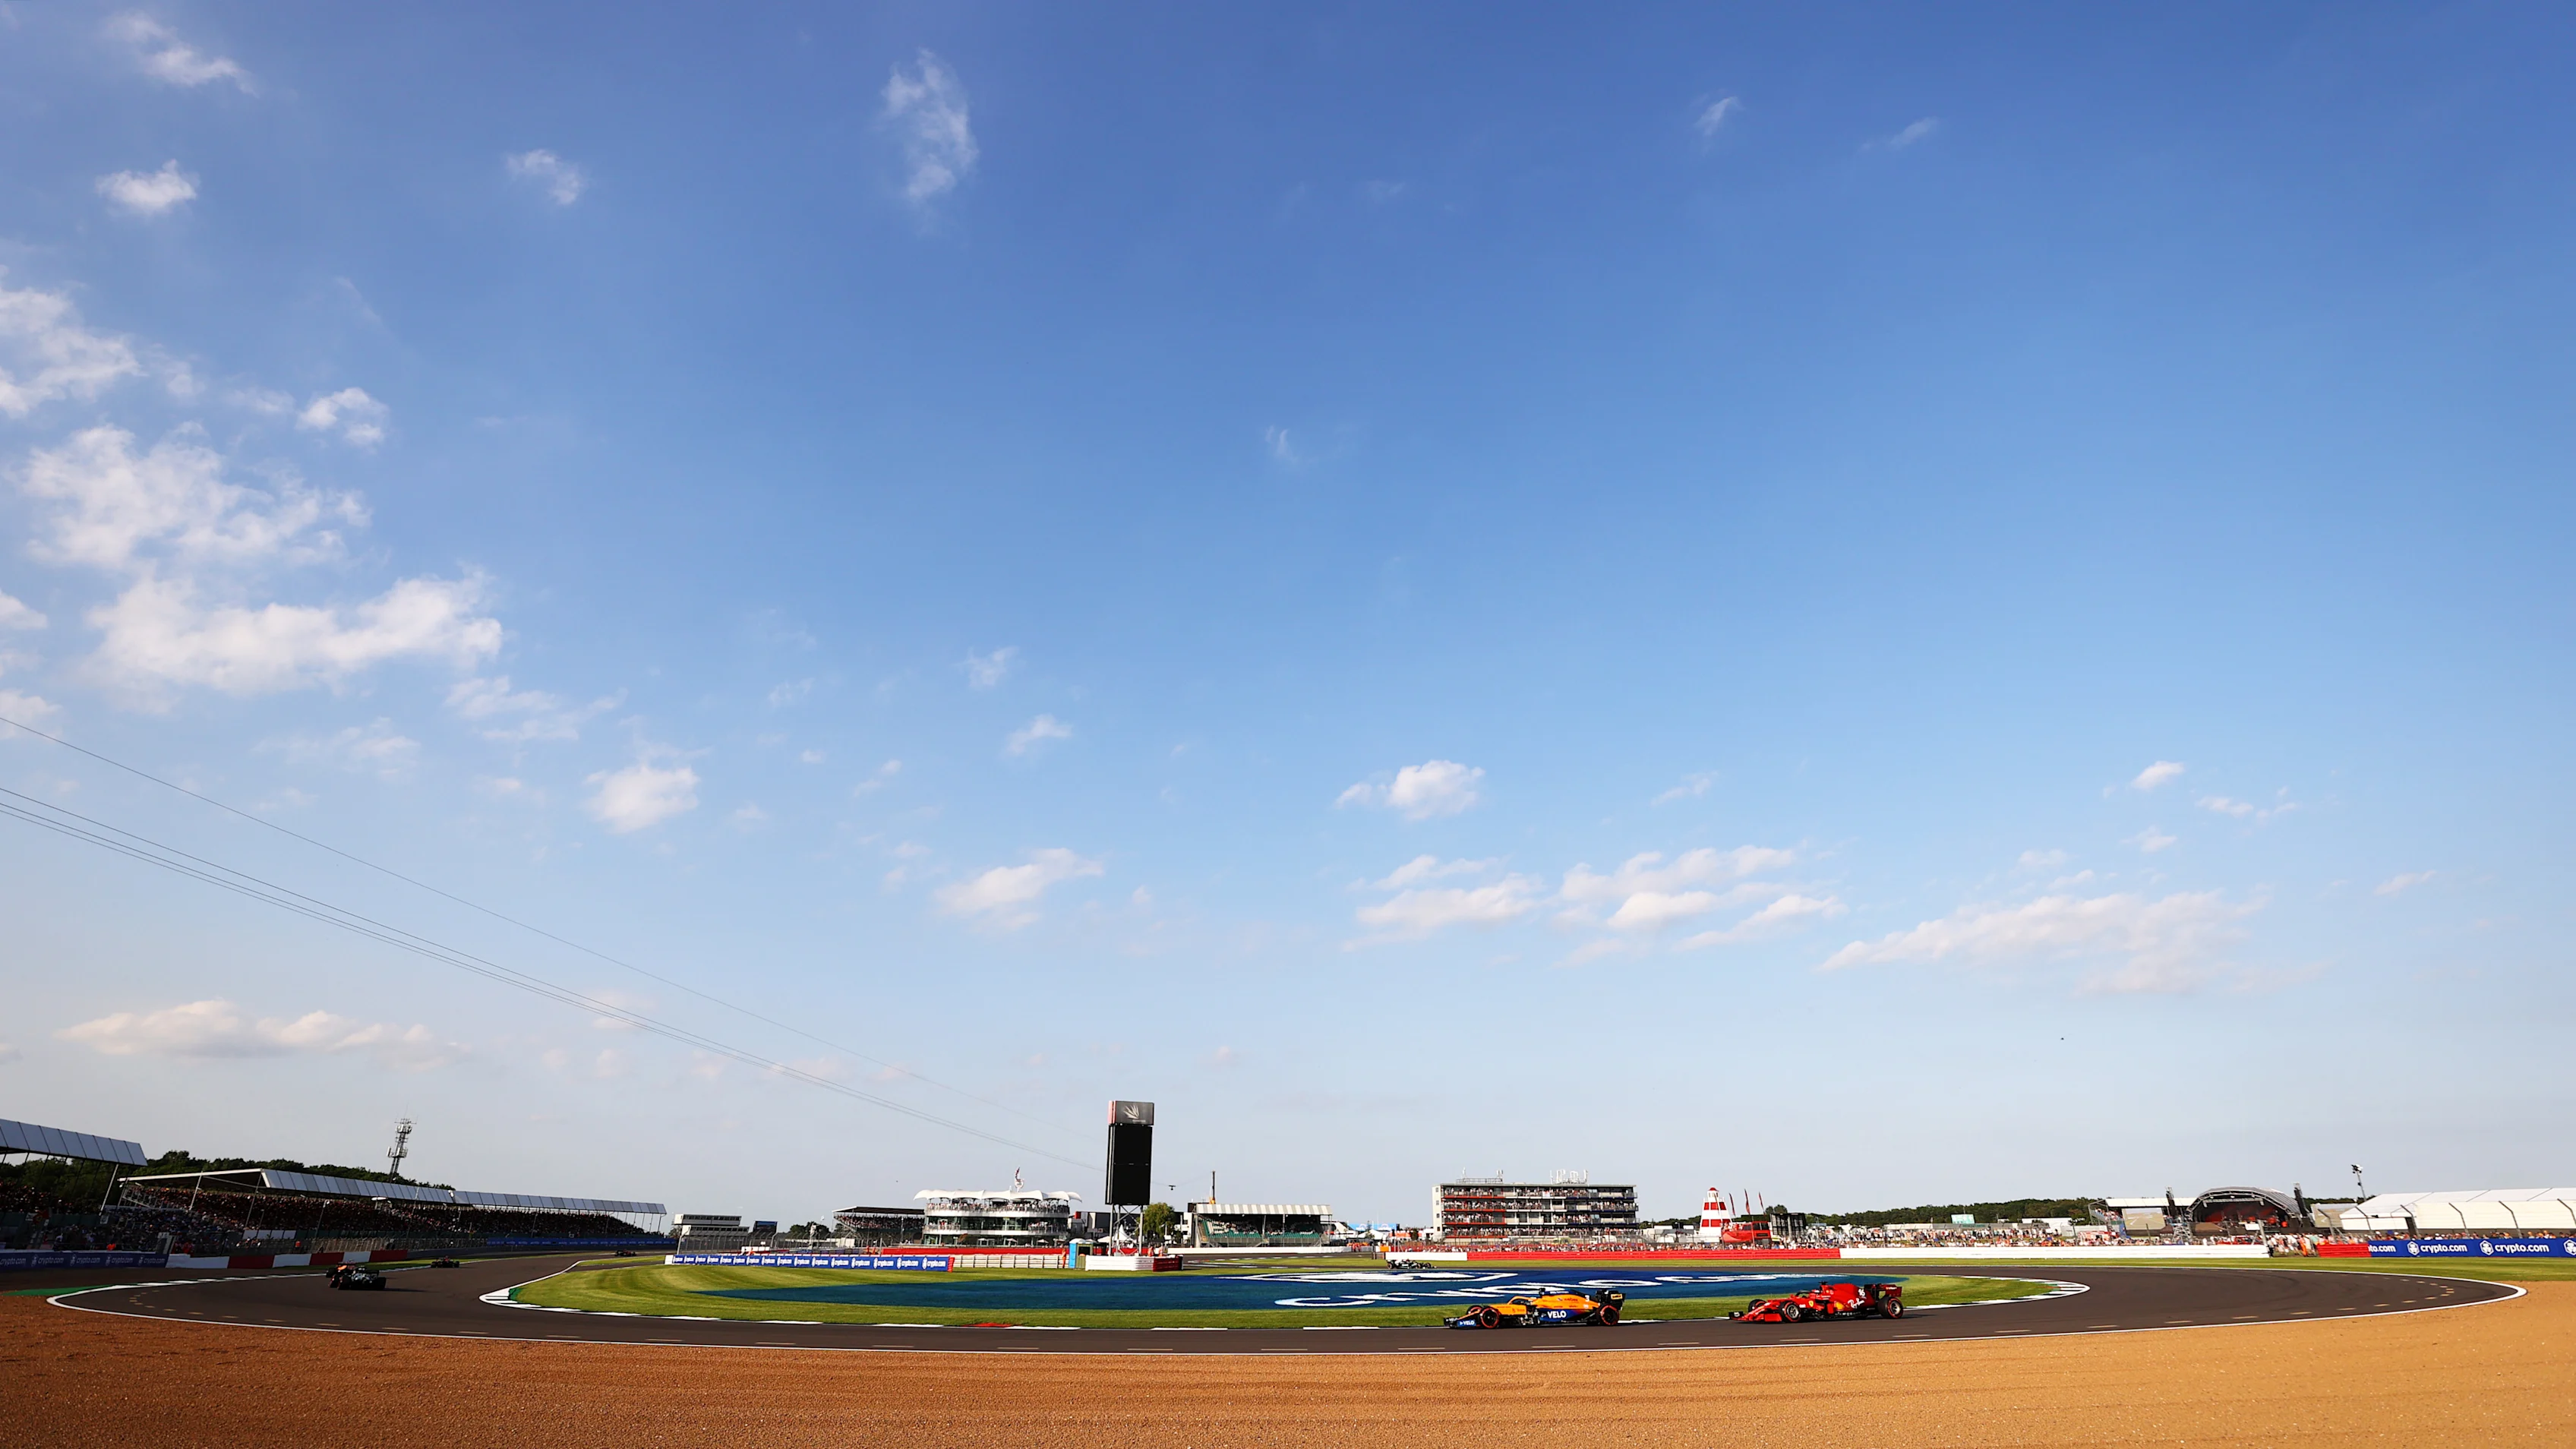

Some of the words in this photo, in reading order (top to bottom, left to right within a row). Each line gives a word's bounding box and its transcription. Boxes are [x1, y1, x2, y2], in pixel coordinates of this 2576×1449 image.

[2420, 1244, 2467, 1253] crypto.com
[2495, 1243, 2549, 1253] crypto.com
[1547, 1310, 1567, 1319] VELO
